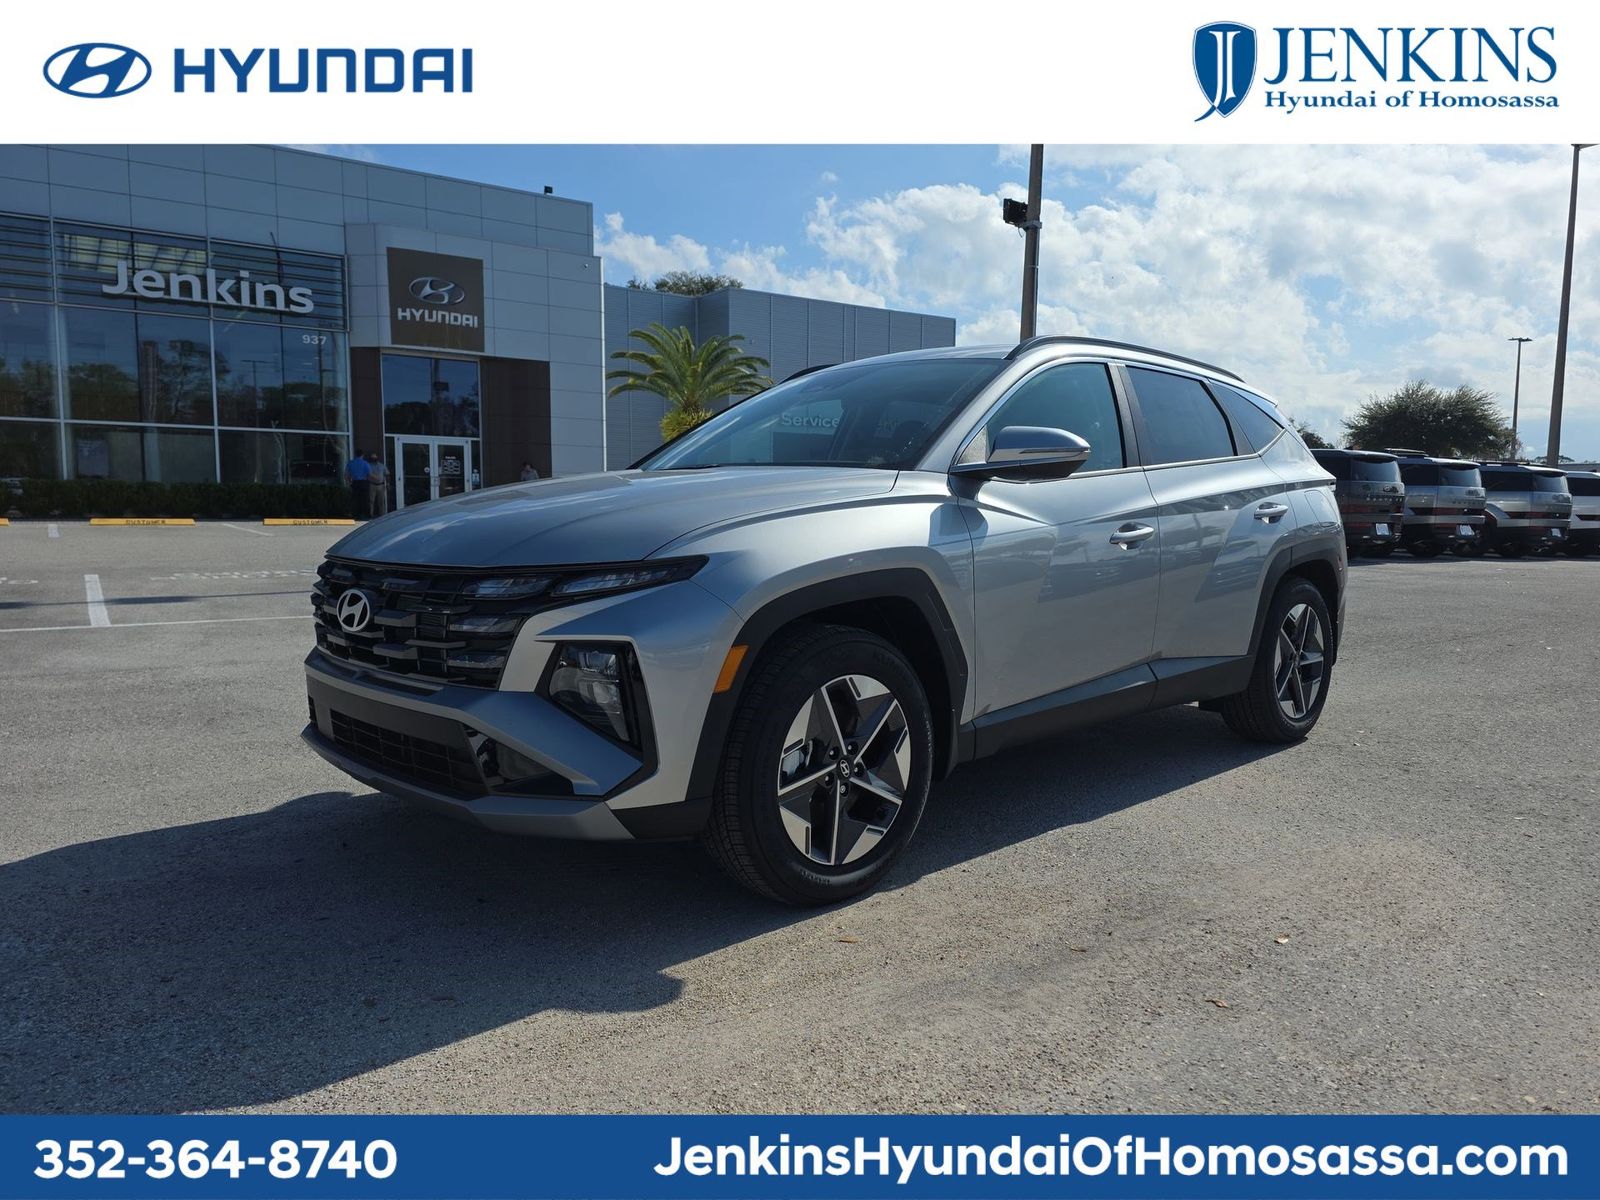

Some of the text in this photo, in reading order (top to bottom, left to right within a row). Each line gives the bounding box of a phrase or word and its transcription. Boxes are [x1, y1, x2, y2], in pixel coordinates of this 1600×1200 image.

[102, 260, 314, 314] Jenkins
[397, 307, 478, 328] HYUNDAI
[302, 334, 327, 345] 937
[781, 412, 839, 427] Service
